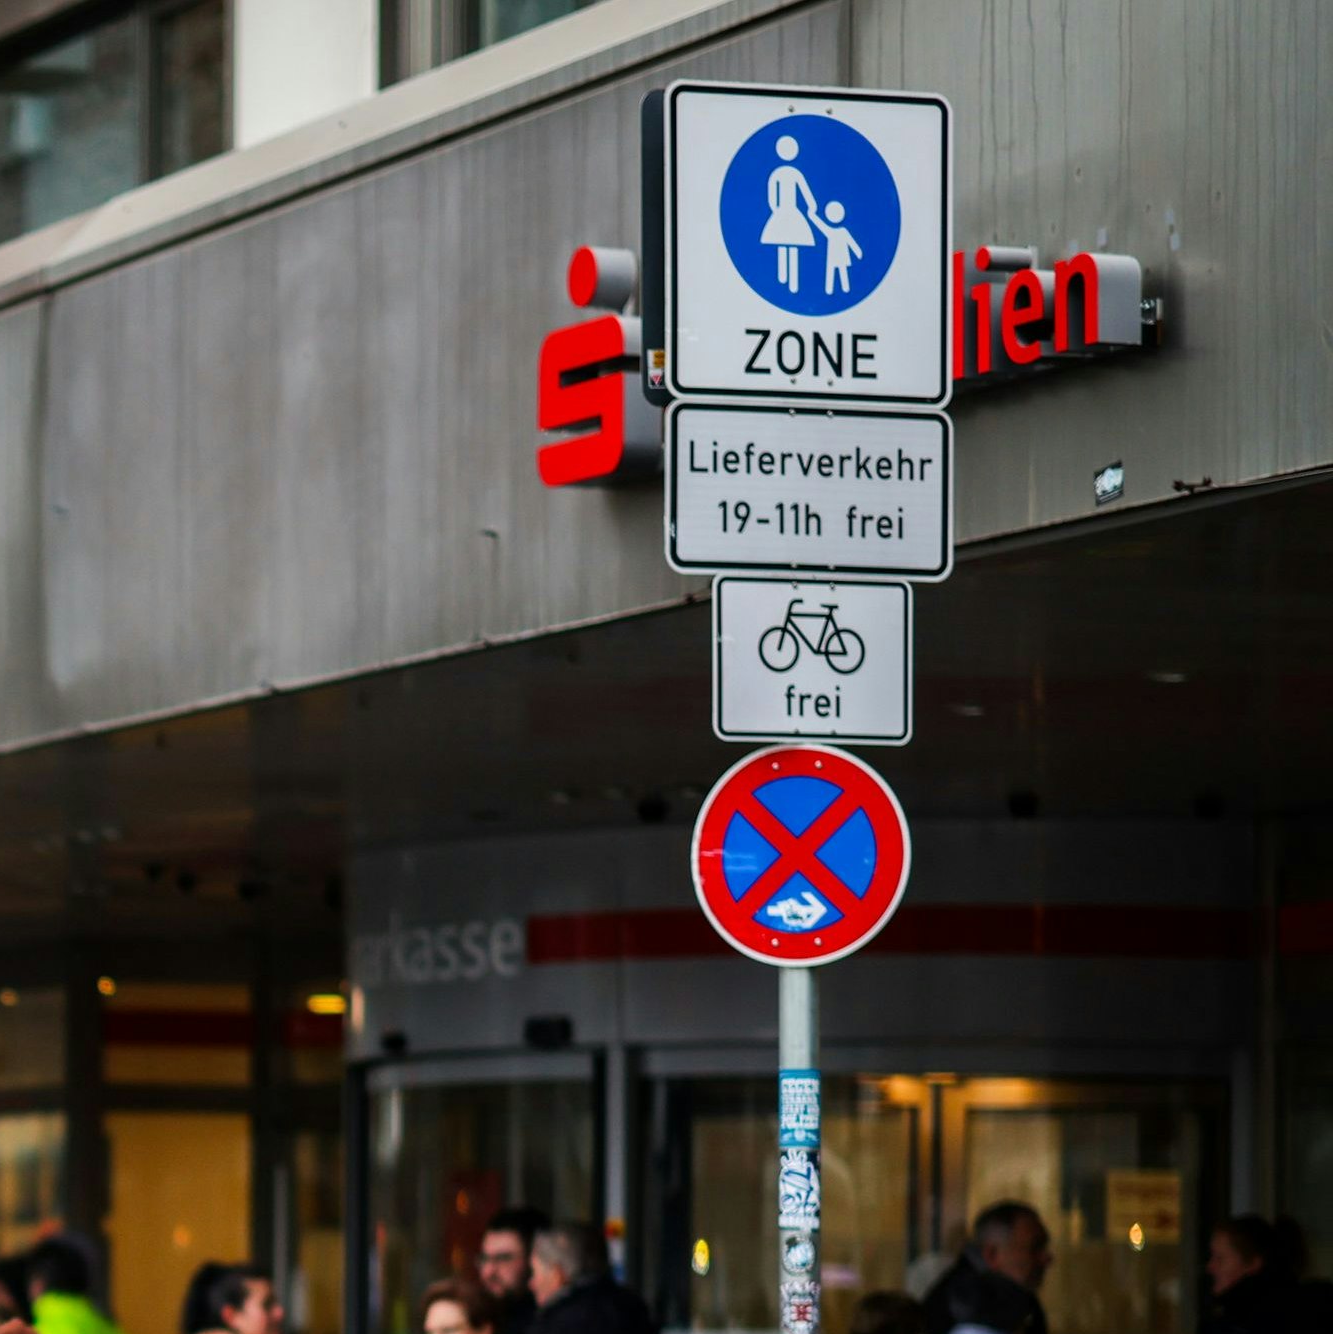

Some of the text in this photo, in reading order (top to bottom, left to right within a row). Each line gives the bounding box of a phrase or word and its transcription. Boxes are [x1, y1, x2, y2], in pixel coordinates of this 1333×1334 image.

[743, 328, 880, 381] ZONE
[687, 439, 935, 482] Lieferverkehr
[718, 501, 906, 541] 19-11h frei
[784, 684, 844, 720] frei
